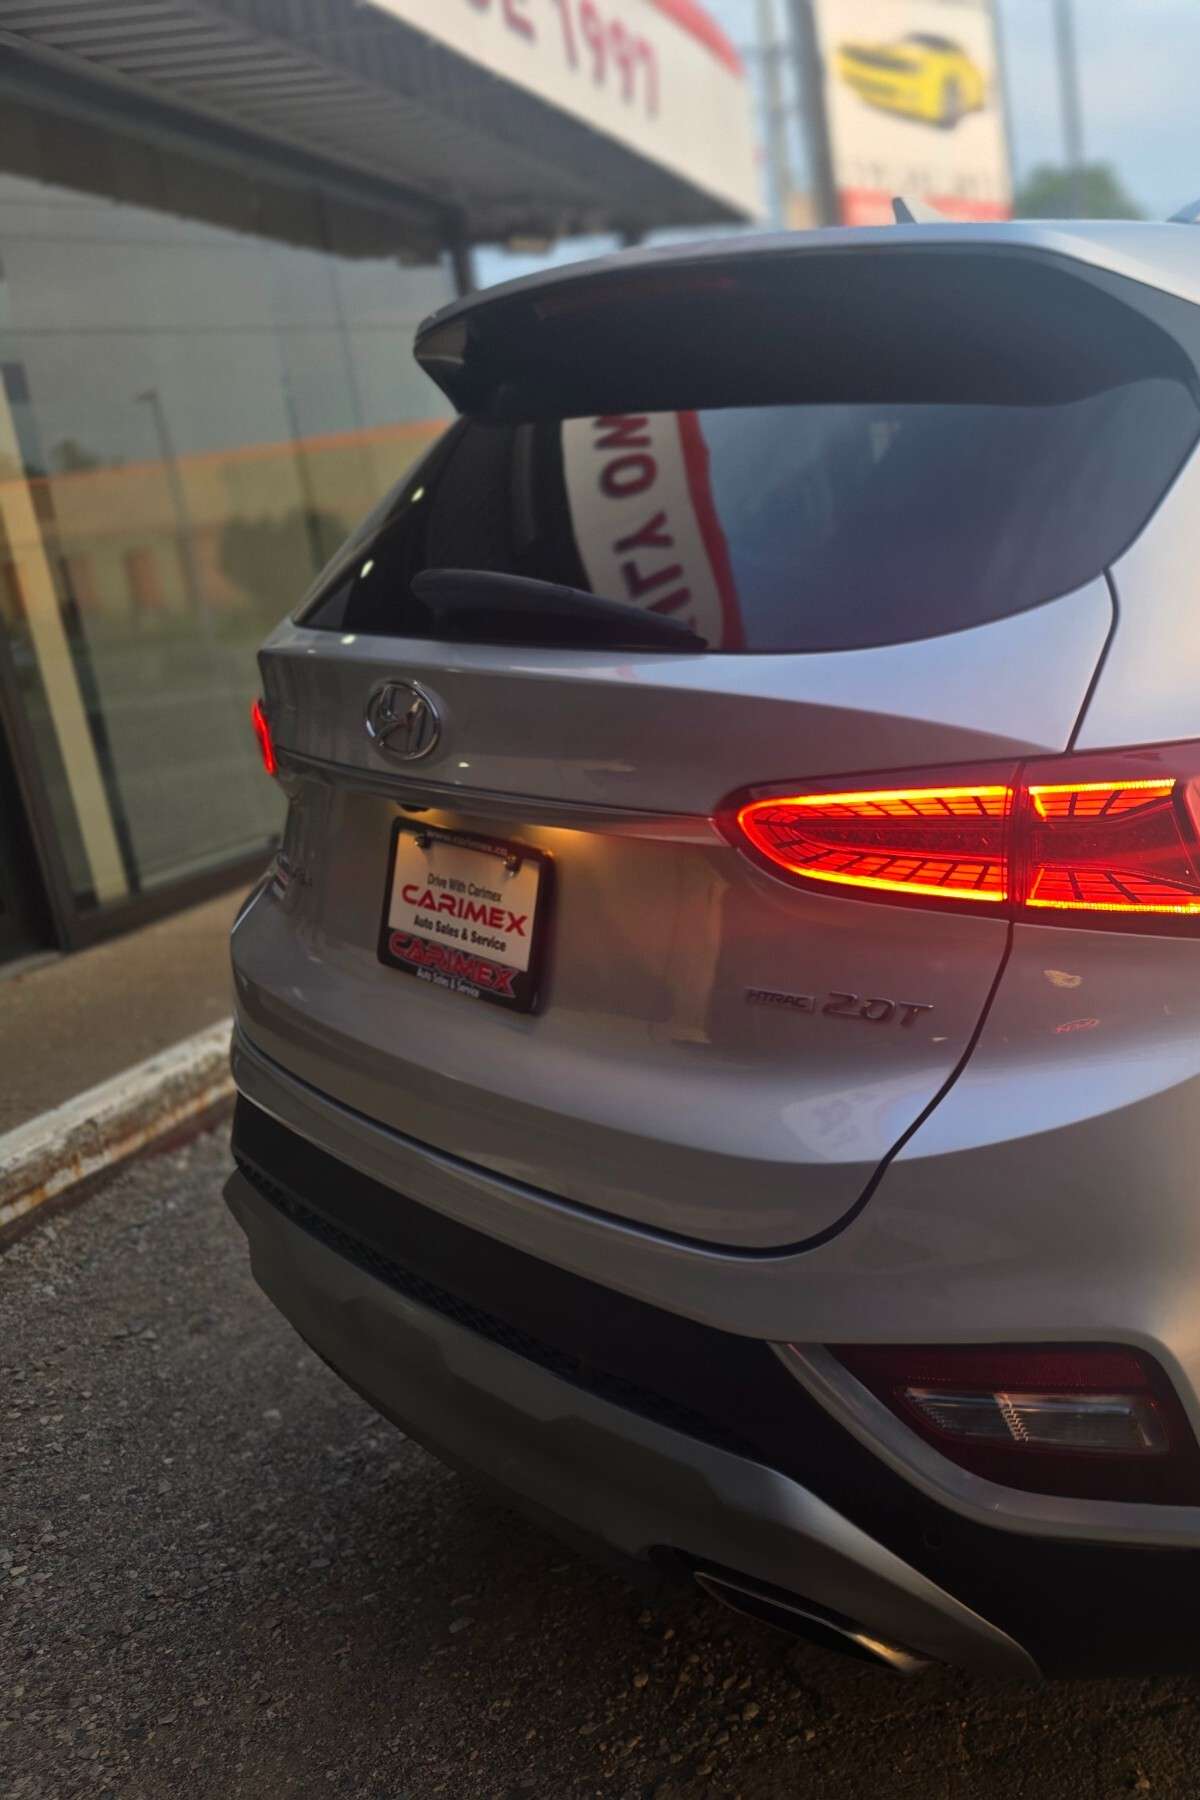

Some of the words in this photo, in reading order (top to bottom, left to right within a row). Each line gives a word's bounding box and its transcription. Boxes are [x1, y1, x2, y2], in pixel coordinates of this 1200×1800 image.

[402, 883, 528, 937] CARIMEX
[427, 872, 447, 889] Drive
[449, 878, 467, 894] With
[468, 883, 502, 902] Carimex
[414, 914, 434, 931] Auto
[436, 919, 459, 939] Sales
[461, 927, 468, 941] &
[470, 930, 507, 953] Service
[389, 930, 520, 998] CARIMEX
